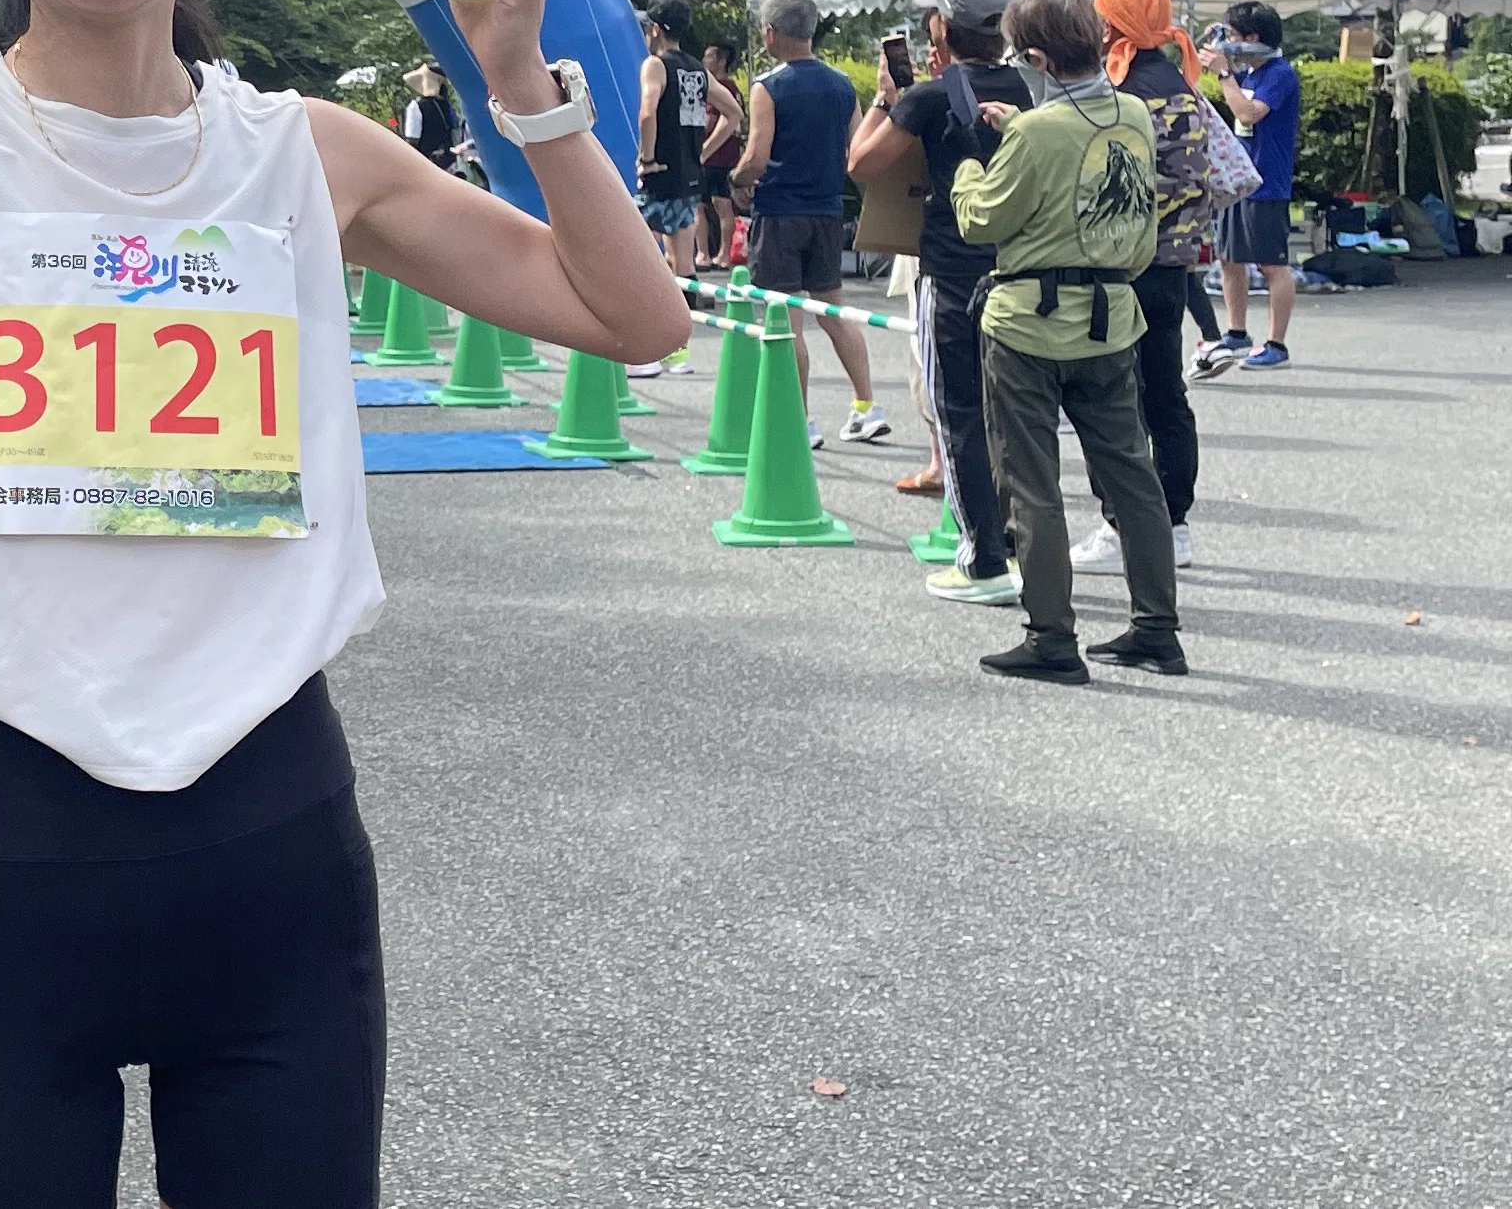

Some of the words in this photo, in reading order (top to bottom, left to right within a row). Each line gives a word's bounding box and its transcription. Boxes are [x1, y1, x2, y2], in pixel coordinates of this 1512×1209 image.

[31, 253, 87, 269] 第36回
[183, 251, 220, 273] 清流
[178, 275, 242, 295] マラソン
